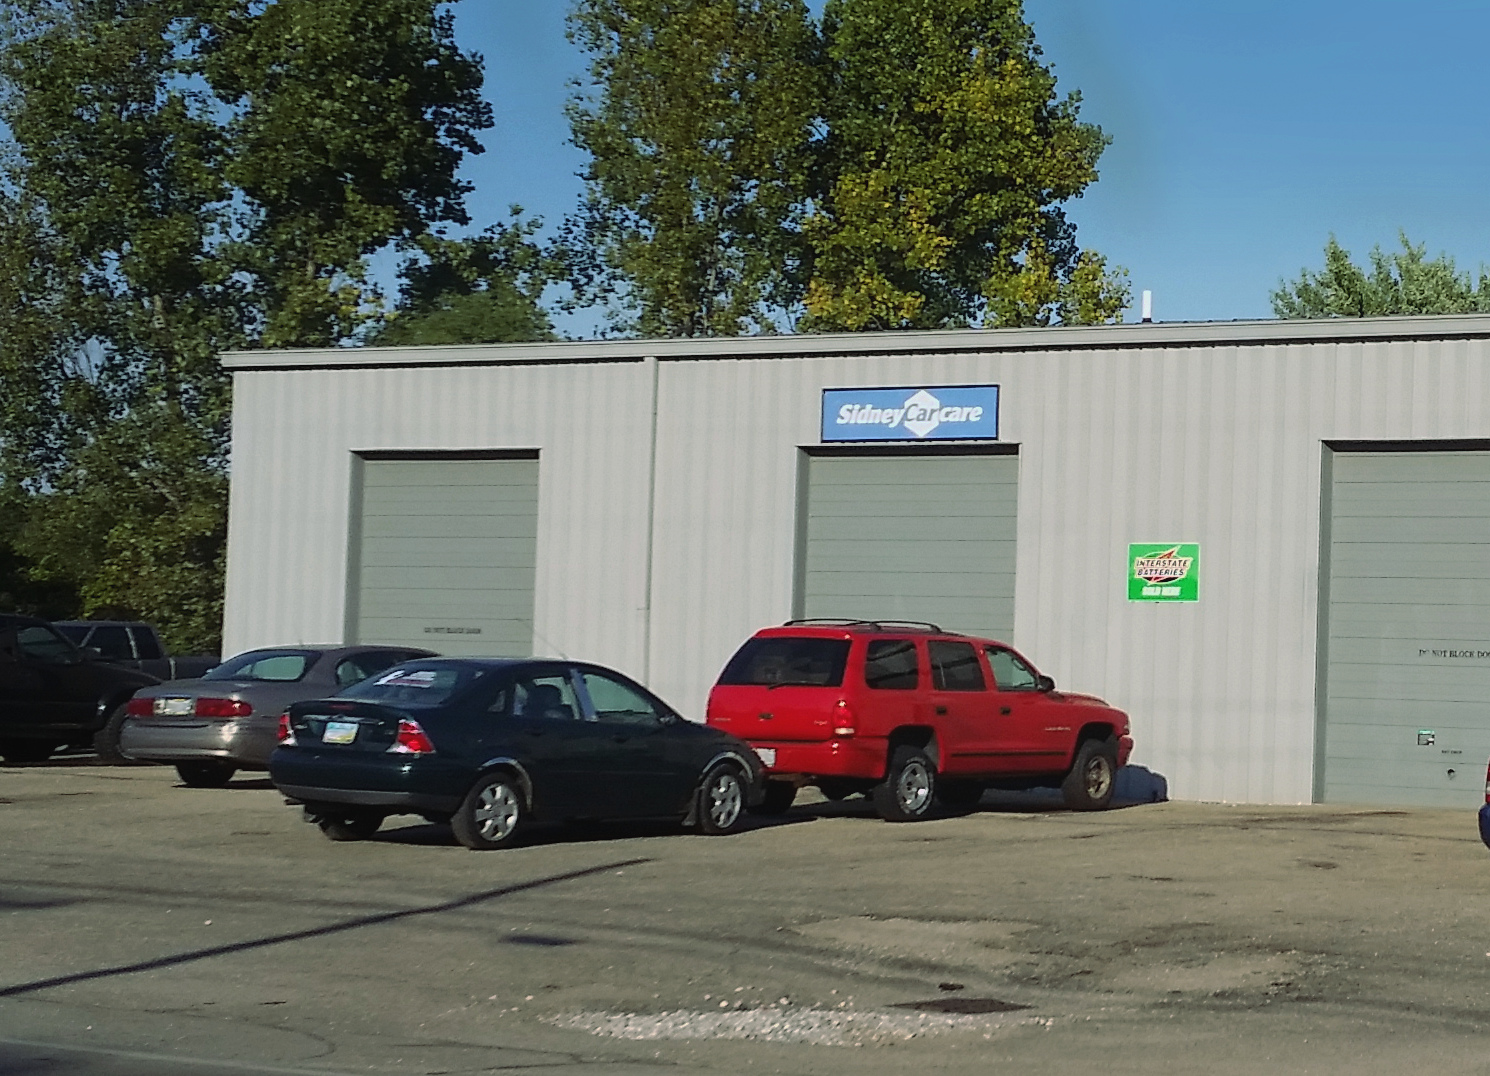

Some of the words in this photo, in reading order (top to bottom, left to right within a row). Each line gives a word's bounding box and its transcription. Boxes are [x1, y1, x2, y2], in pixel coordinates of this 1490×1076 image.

[1136, 559, 1188, 567] INTERSTATE
[1137, 568, 1184, 576] BATTERIES
[1432, 649, 1447, 657] NOT
[1449, 650, 1475, 658] BLOCK
